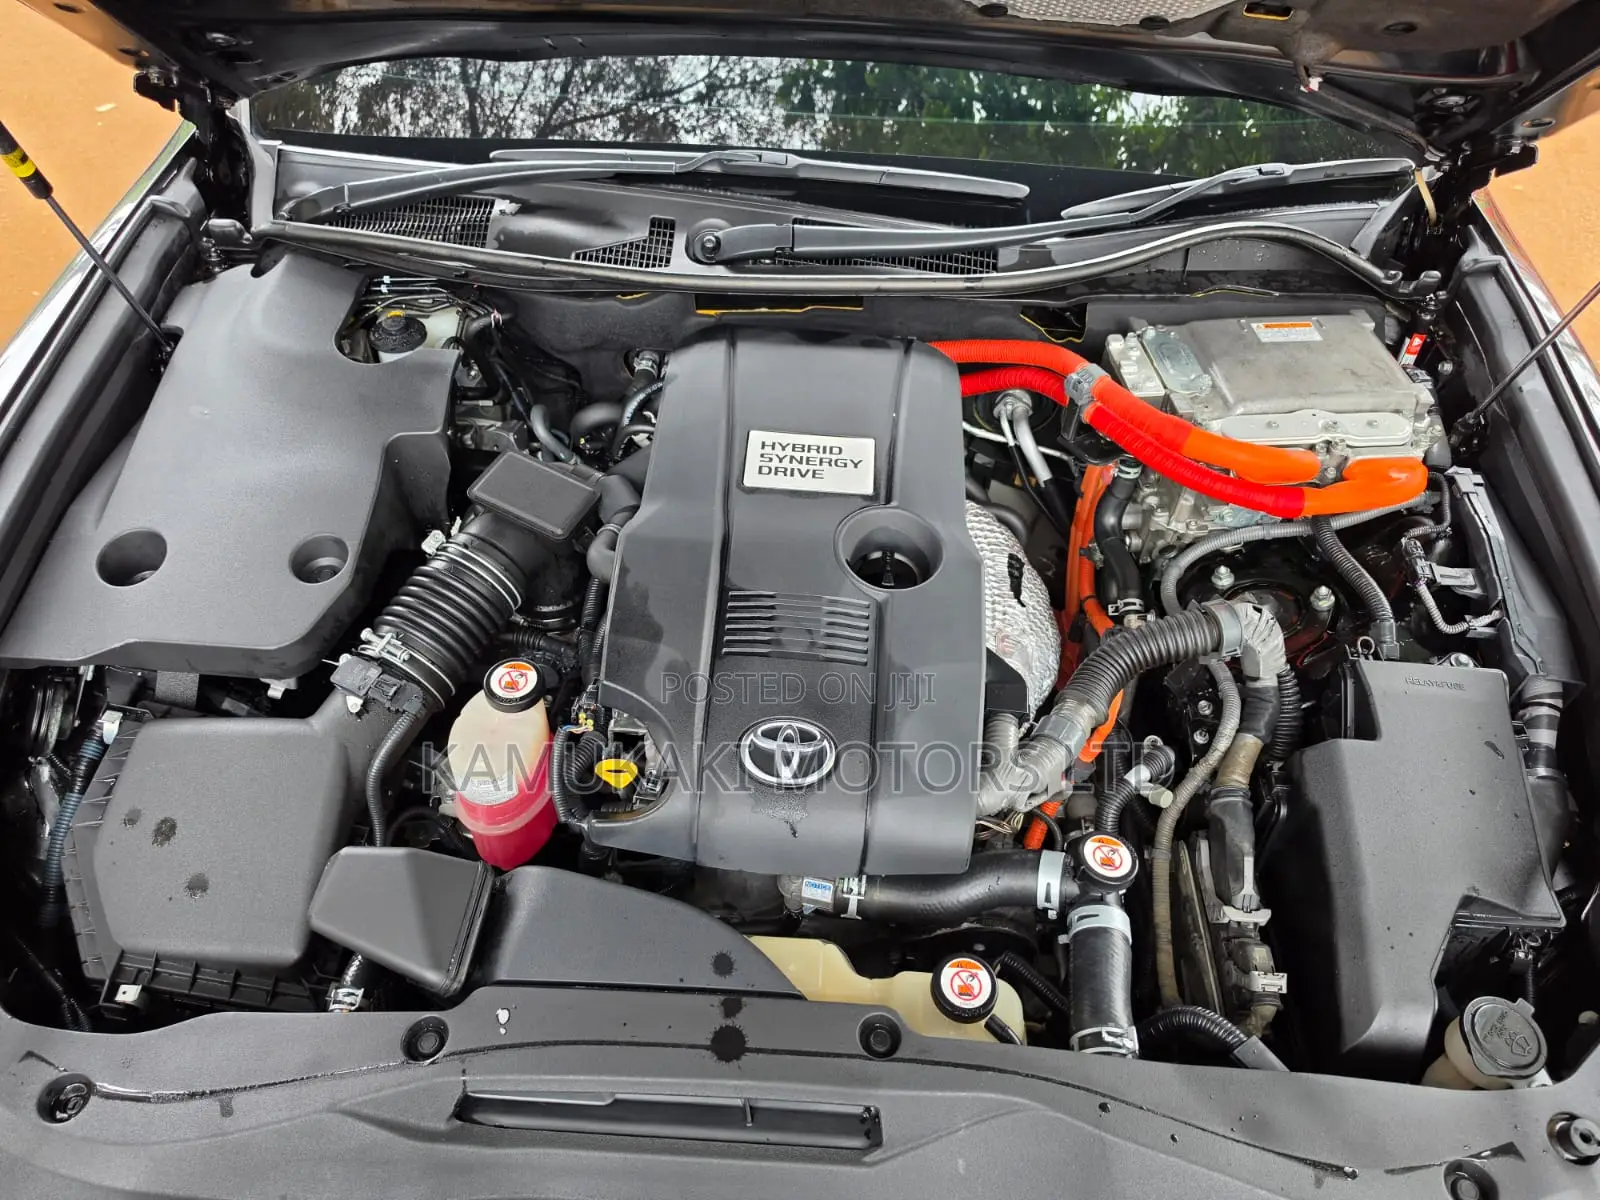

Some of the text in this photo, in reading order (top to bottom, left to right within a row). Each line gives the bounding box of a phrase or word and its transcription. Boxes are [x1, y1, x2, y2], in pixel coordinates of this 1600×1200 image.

[760, 441, 843, 456] HYBRID
[759, 453, 863, 469] SYNERGY
[758, 465, 825, 479] DRIVE
